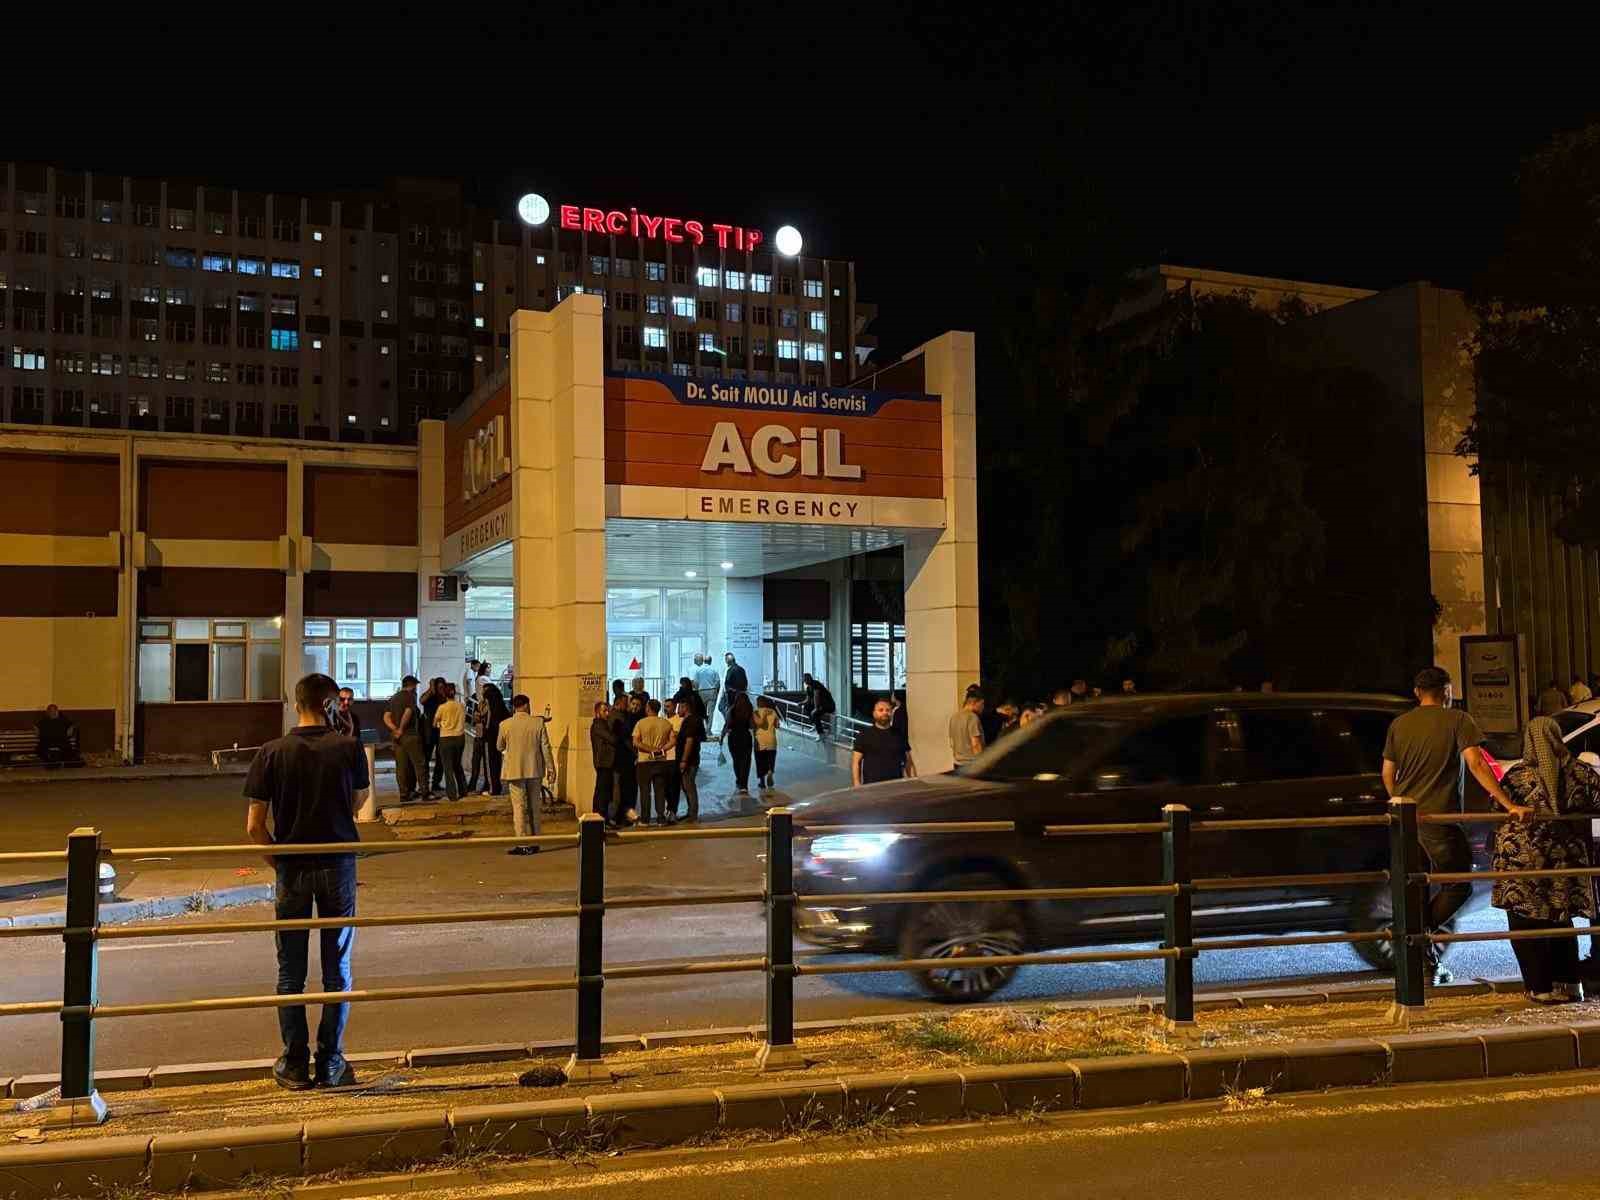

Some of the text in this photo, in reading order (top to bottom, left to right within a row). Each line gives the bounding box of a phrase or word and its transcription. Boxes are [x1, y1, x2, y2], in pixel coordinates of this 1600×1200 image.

[561, 205, 764, 251] ERCİYES TIP
[687, 382, 866, 411] Dr. Sait MOLU Acil Servisi
[701, 496, 858, 518] EMERGENCY
